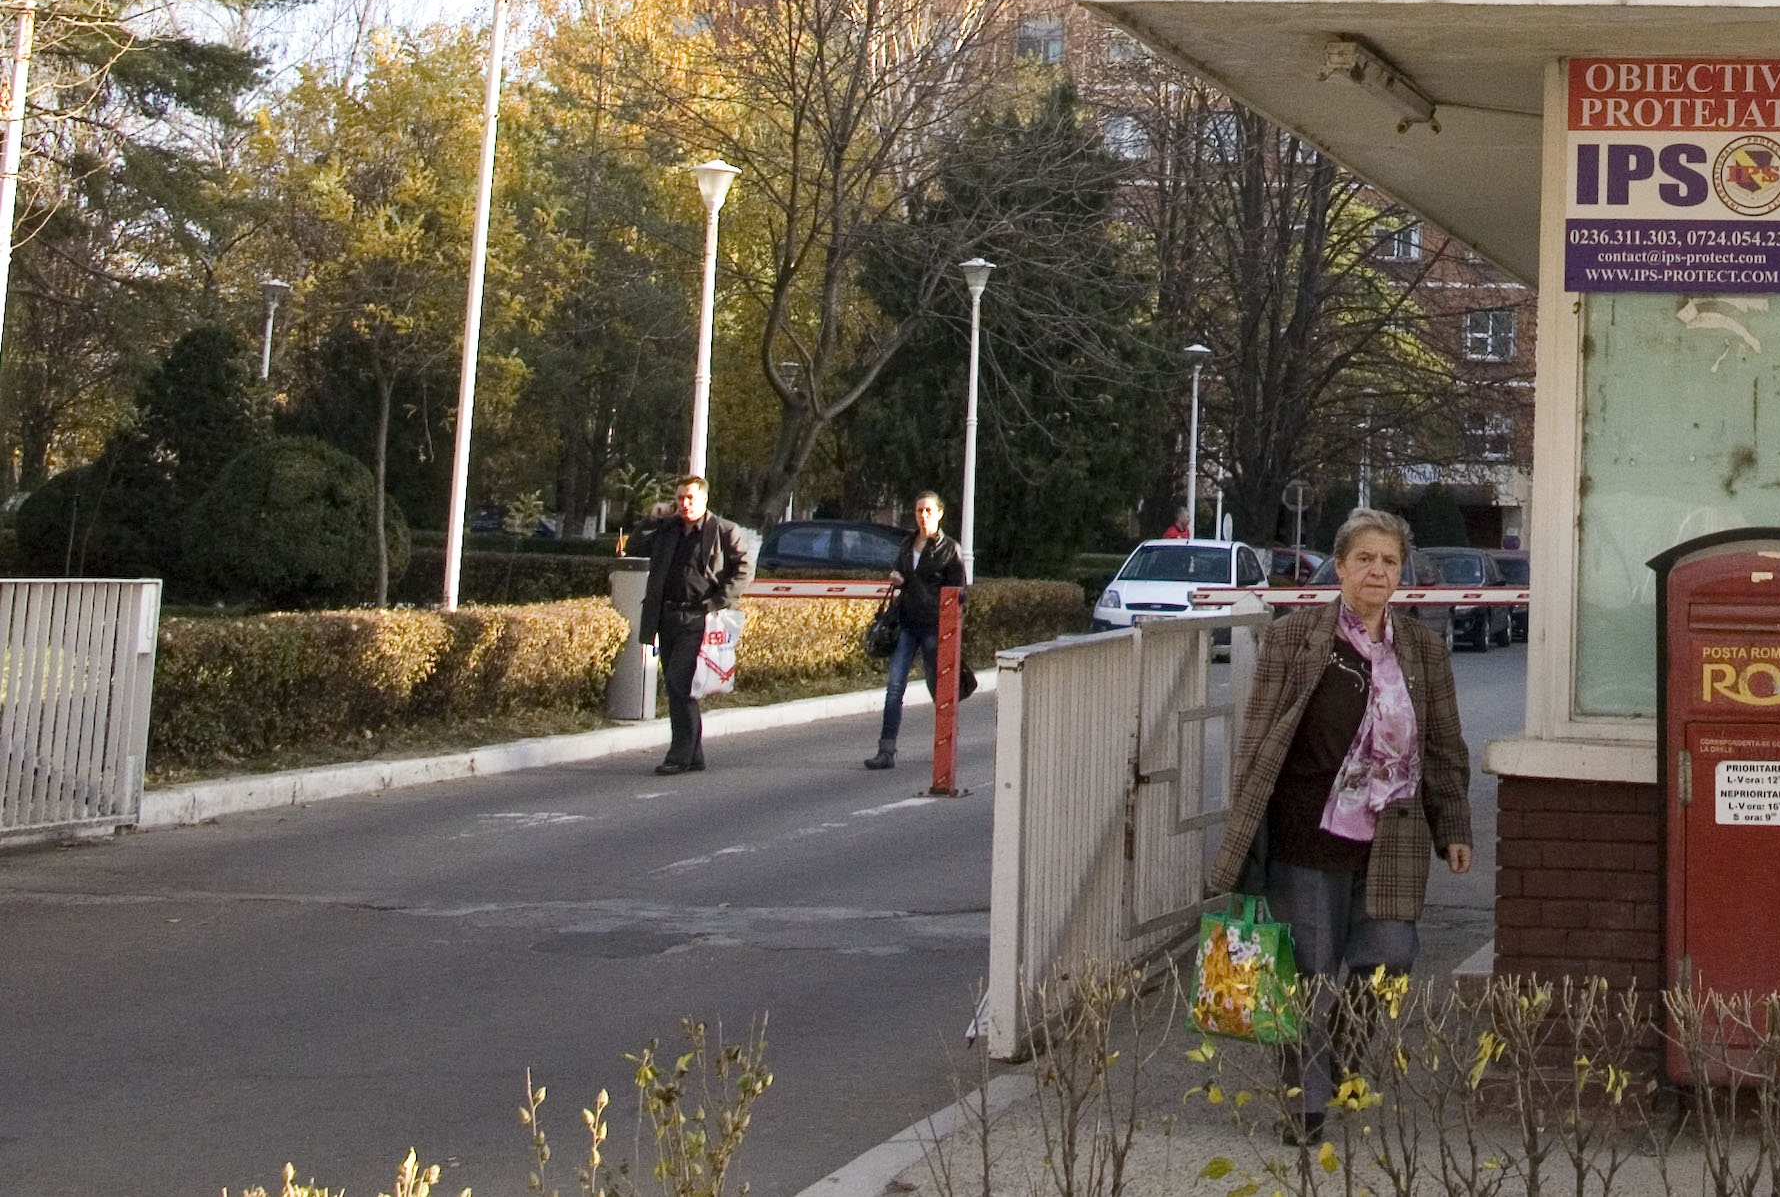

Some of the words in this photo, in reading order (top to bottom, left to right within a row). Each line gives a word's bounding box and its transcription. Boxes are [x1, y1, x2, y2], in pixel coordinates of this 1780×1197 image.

[1576, 143, 1709, 207] IPS
[1726, 165, 1780, 183] IPS
[1569, 229, 1683, 247] 0236.311.303,
[1597, 250, 1768, 266] contact@ips-protect.com
[1585, 268, 1780, 283] WWW.IPS-PROTECT.COM
